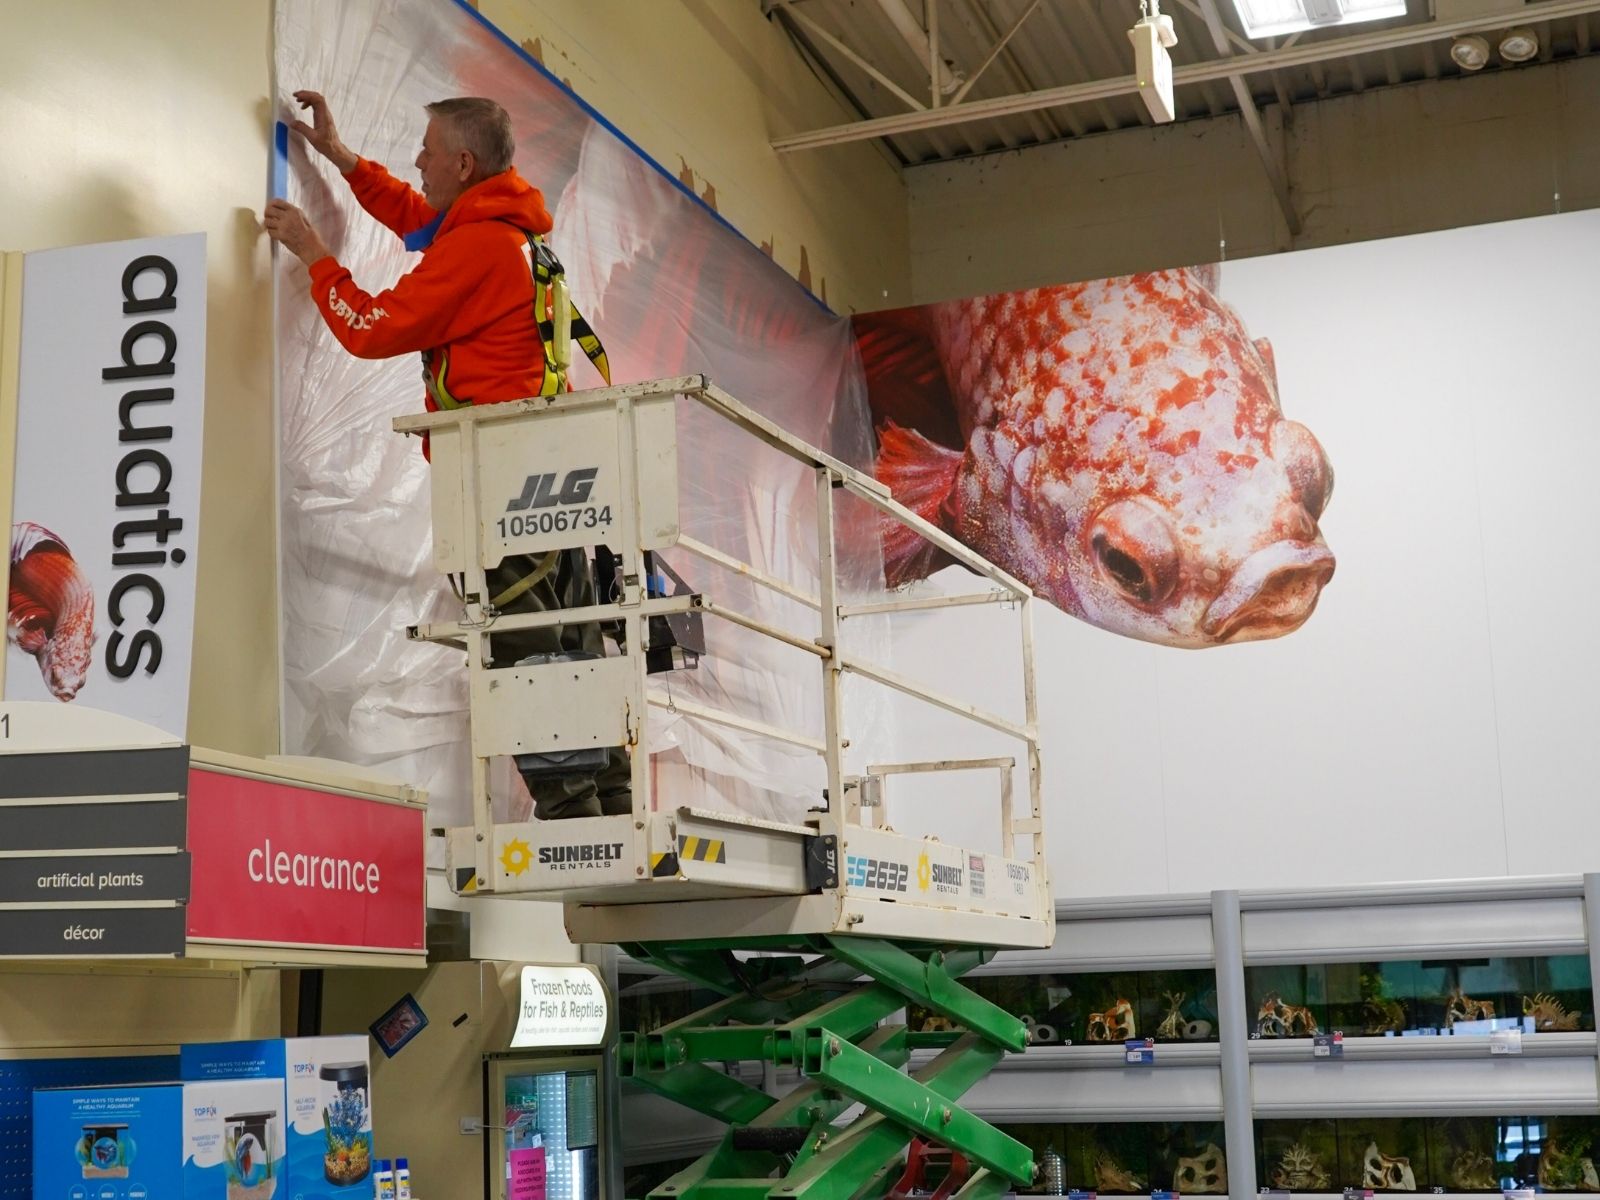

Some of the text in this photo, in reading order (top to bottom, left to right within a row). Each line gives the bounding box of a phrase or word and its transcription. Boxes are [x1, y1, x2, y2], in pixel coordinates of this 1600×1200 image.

[102, 254, 186, 679] aquatics
[506, 467, 599, 512] JLG
[497, 505, 612, 538] 10506734
[538, 843, 624, 864] SUNBELT
[825, 849, 836, 873] JLG
[248, 839, 380, 894] clearance
[550, 861, 612, 871] RENTALS
[932, 863, 963, 887] SUNBELT
[36, 871, 144, 890] artificial plants
[936, 884, 959, 896] RENTALS
[63, 924, 105, 942] décor
[530, 978, 593, 996] Frozen Foods
[523, 1001, 604, 1021] for Fish & Reptiles
[293, 1064, 305, 1073] TOP
[193, 1108, 206, 1116] TOP
